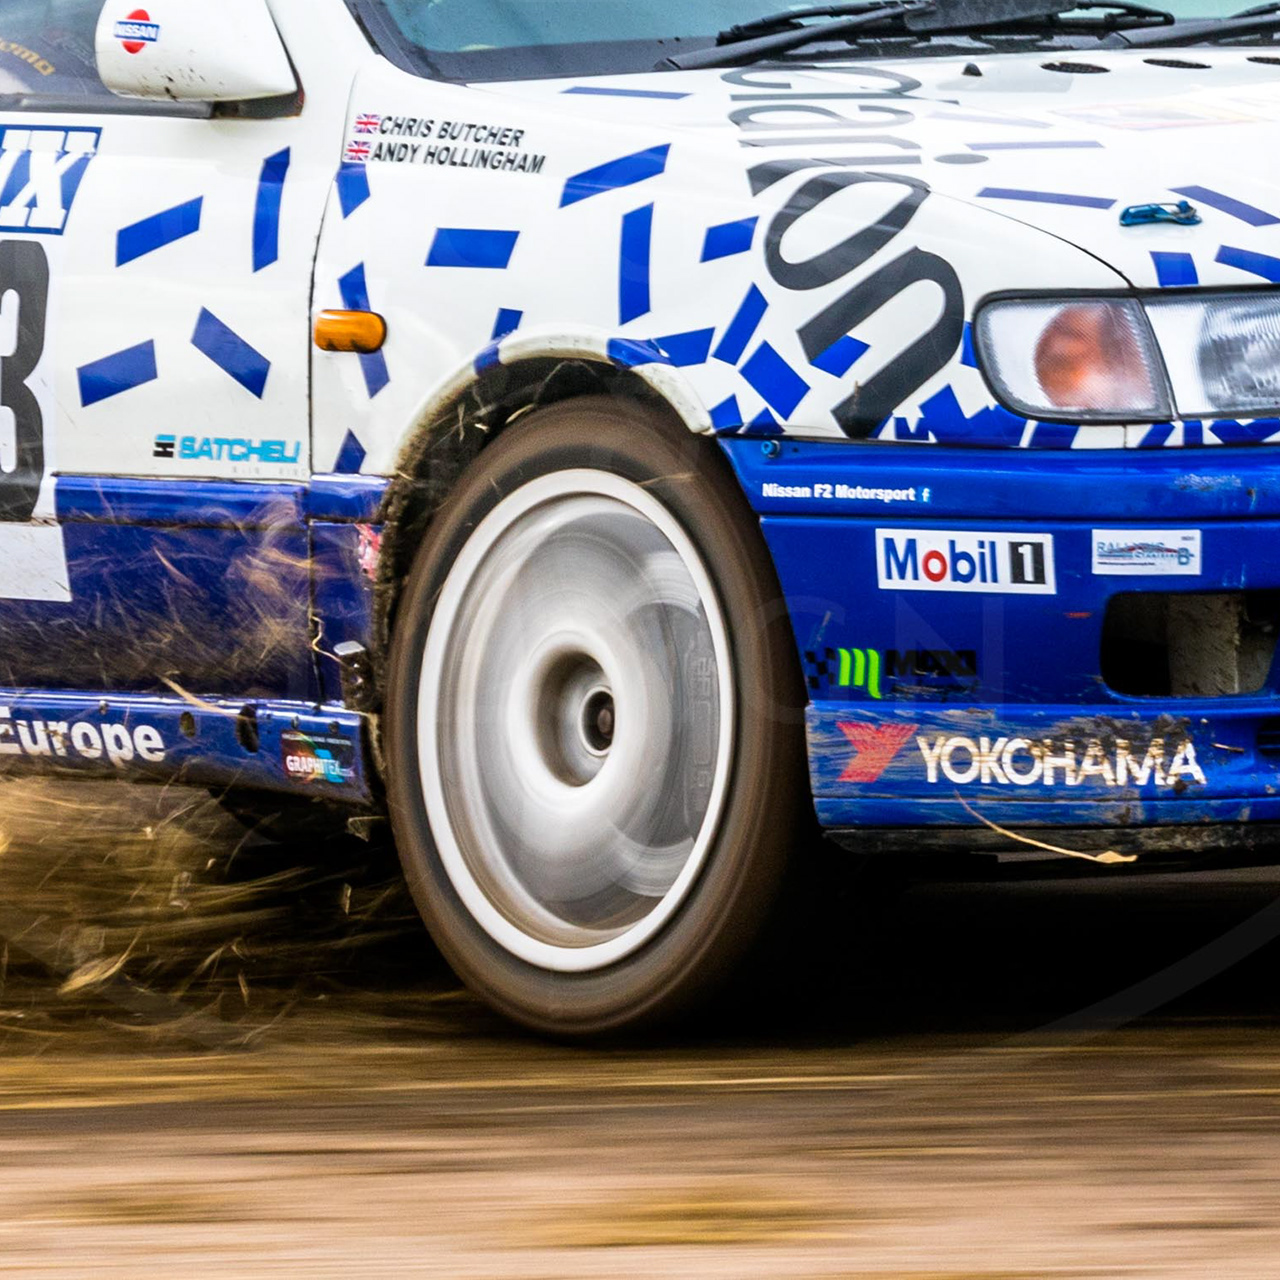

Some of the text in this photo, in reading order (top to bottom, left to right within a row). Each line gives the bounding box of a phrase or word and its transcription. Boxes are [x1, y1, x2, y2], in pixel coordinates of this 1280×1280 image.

[114, 22, 159, 41] NISSAN
[379, 115, 526, 148] CHRIS BUTCHER
[371, 142, 547, 174] ANDY HOLLINGHAM
[762, 482, 812, 499] Nissan
[813, 483, 834, 499] F2
[834, 484, 916, 503] Motorsport
[884, 537, 998, 584] Mobil
[917, 734, 1207, 787] YOKOHAMA
